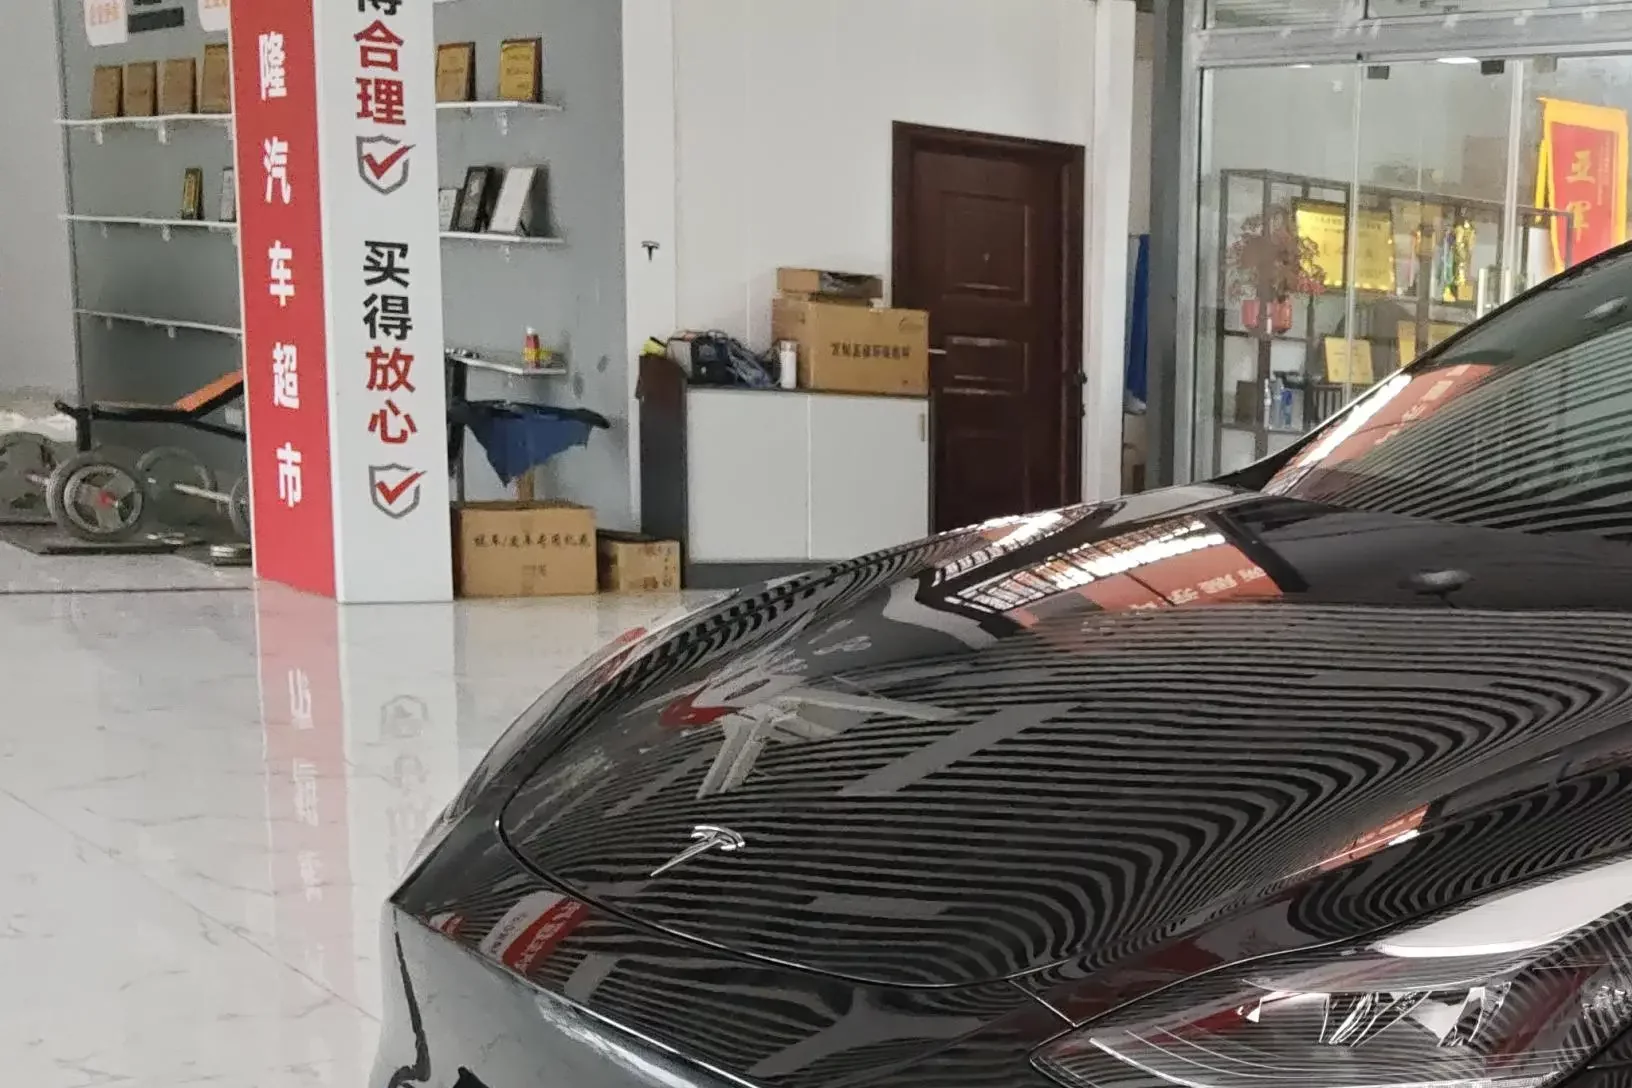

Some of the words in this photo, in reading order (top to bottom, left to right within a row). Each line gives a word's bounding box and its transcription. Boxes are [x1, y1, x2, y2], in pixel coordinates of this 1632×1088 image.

[258, 30, 302, 508] 隆汽车超市
[362, 240, 418, 444] 买得放心
